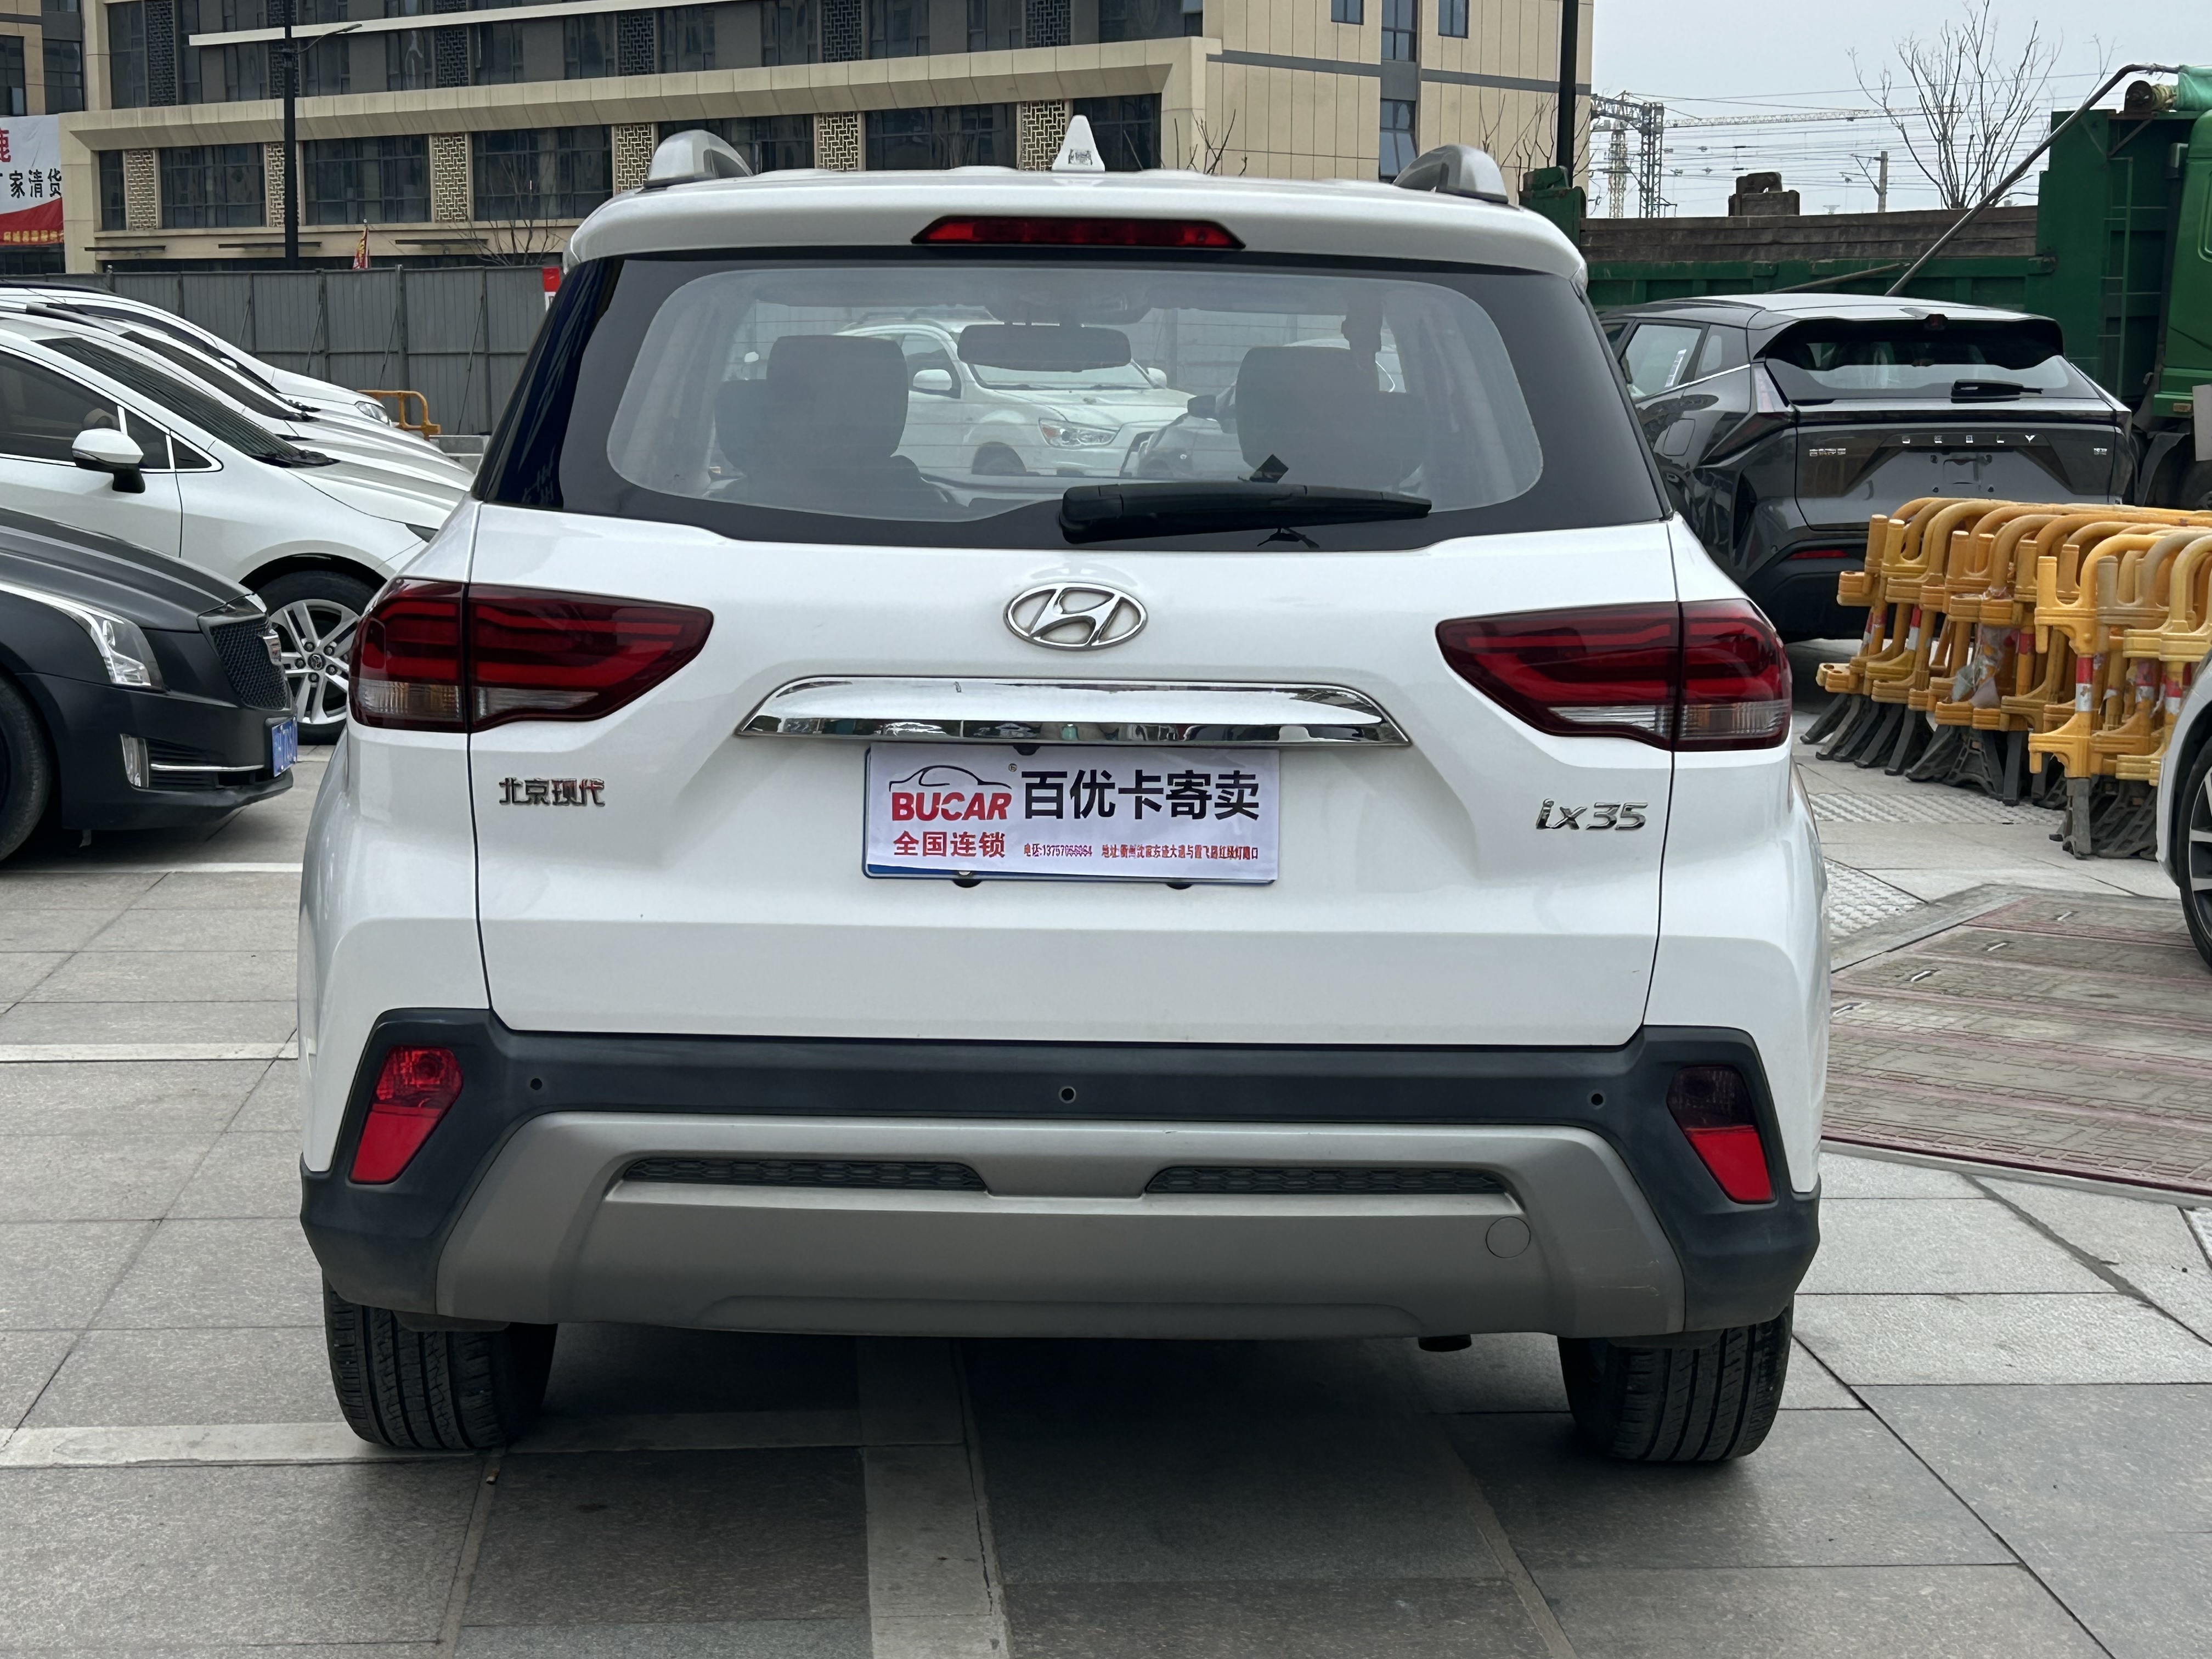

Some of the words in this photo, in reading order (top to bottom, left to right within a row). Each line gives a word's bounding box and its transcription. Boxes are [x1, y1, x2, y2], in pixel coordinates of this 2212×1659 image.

[0, 168, 61, 198] 家清货
[499, 777, 606, 806] 北京现代
[1022, 769, 1260, 821] 百优卡寄卖
[892, 792, 1012, 821] BUCAR
[1536, 798, 1649, 830] ix35
[893, 831, 1005, 857] 全国连锁
